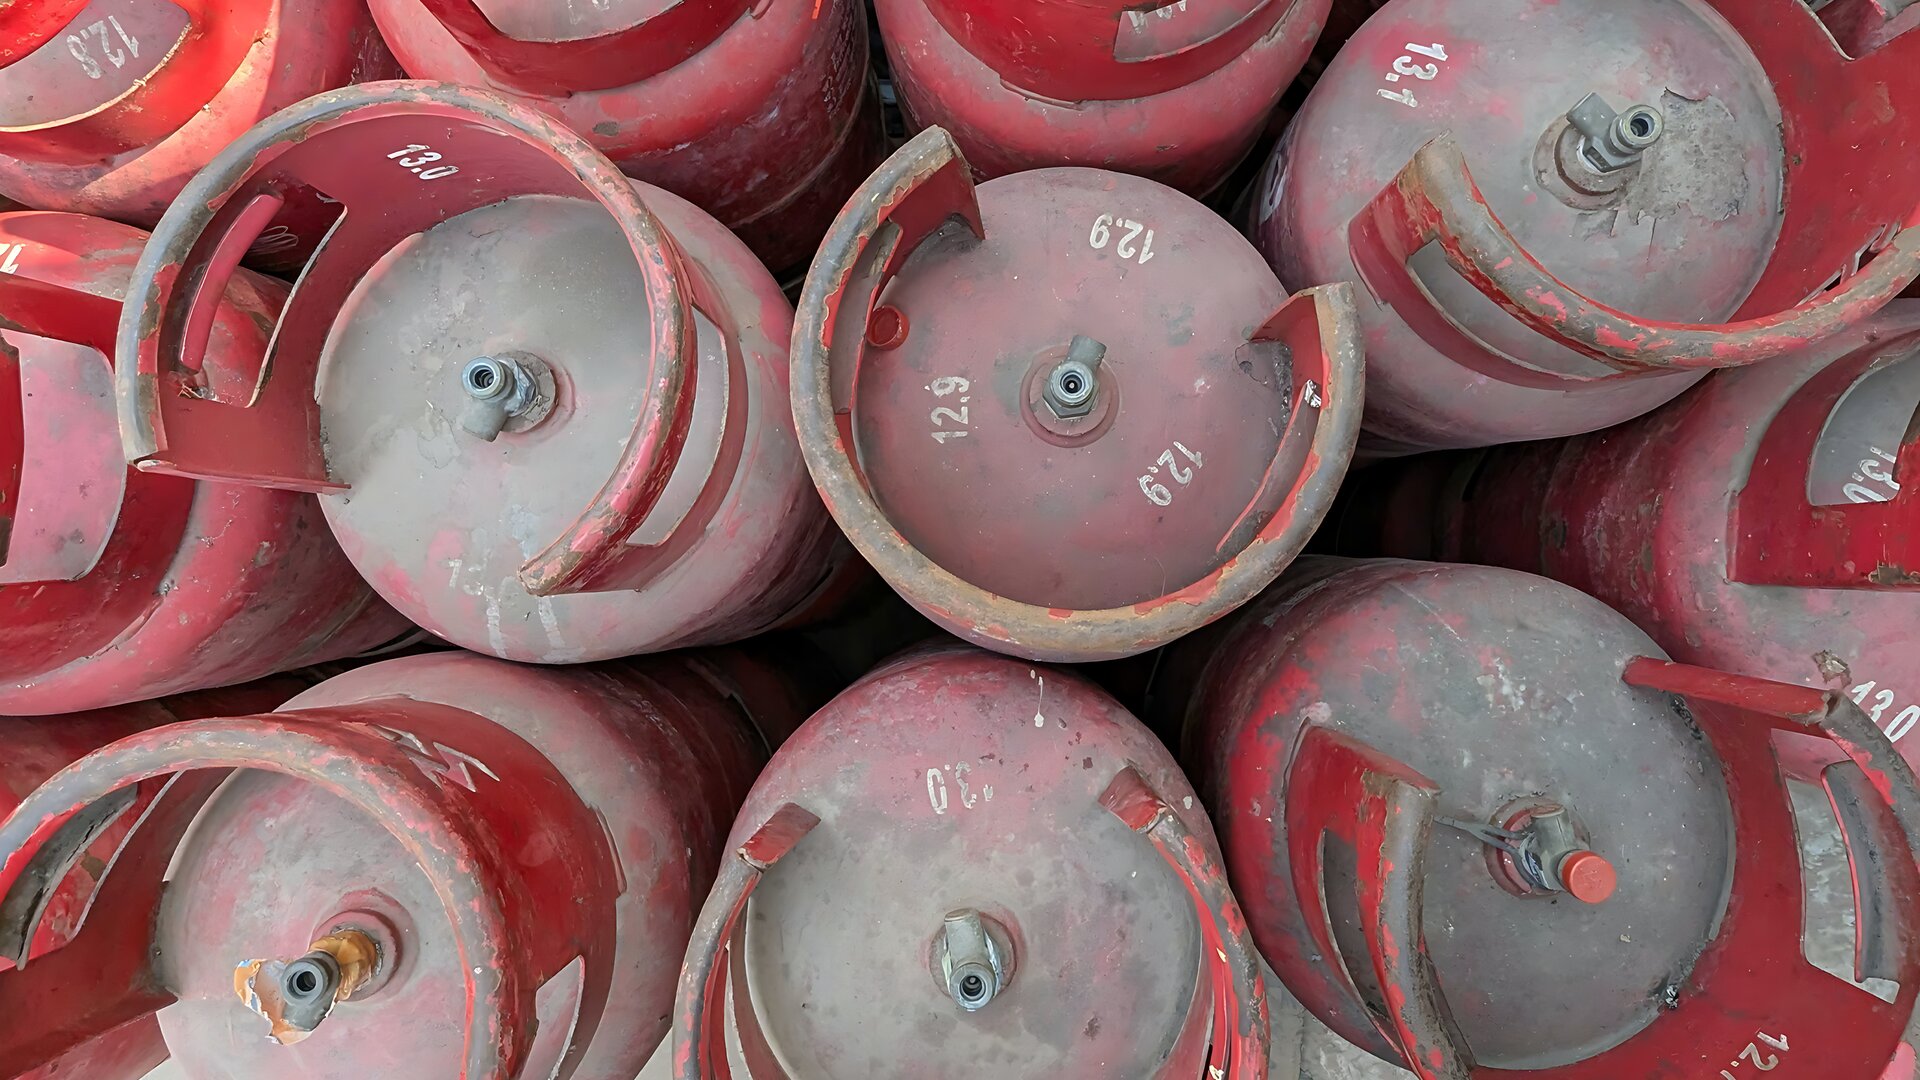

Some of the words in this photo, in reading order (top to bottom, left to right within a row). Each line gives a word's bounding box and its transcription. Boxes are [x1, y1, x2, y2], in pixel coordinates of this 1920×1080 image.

[66, 15, 139, 79] 12.8
[1376, 43, 1448, 108] 13.1
[386, 144, 460, 180] 13.0
[1089, 212, 1154, 265] 12.9
[930, 376, 970, 445] 12.9
[1138, 441, 1203, 506] 12.9
